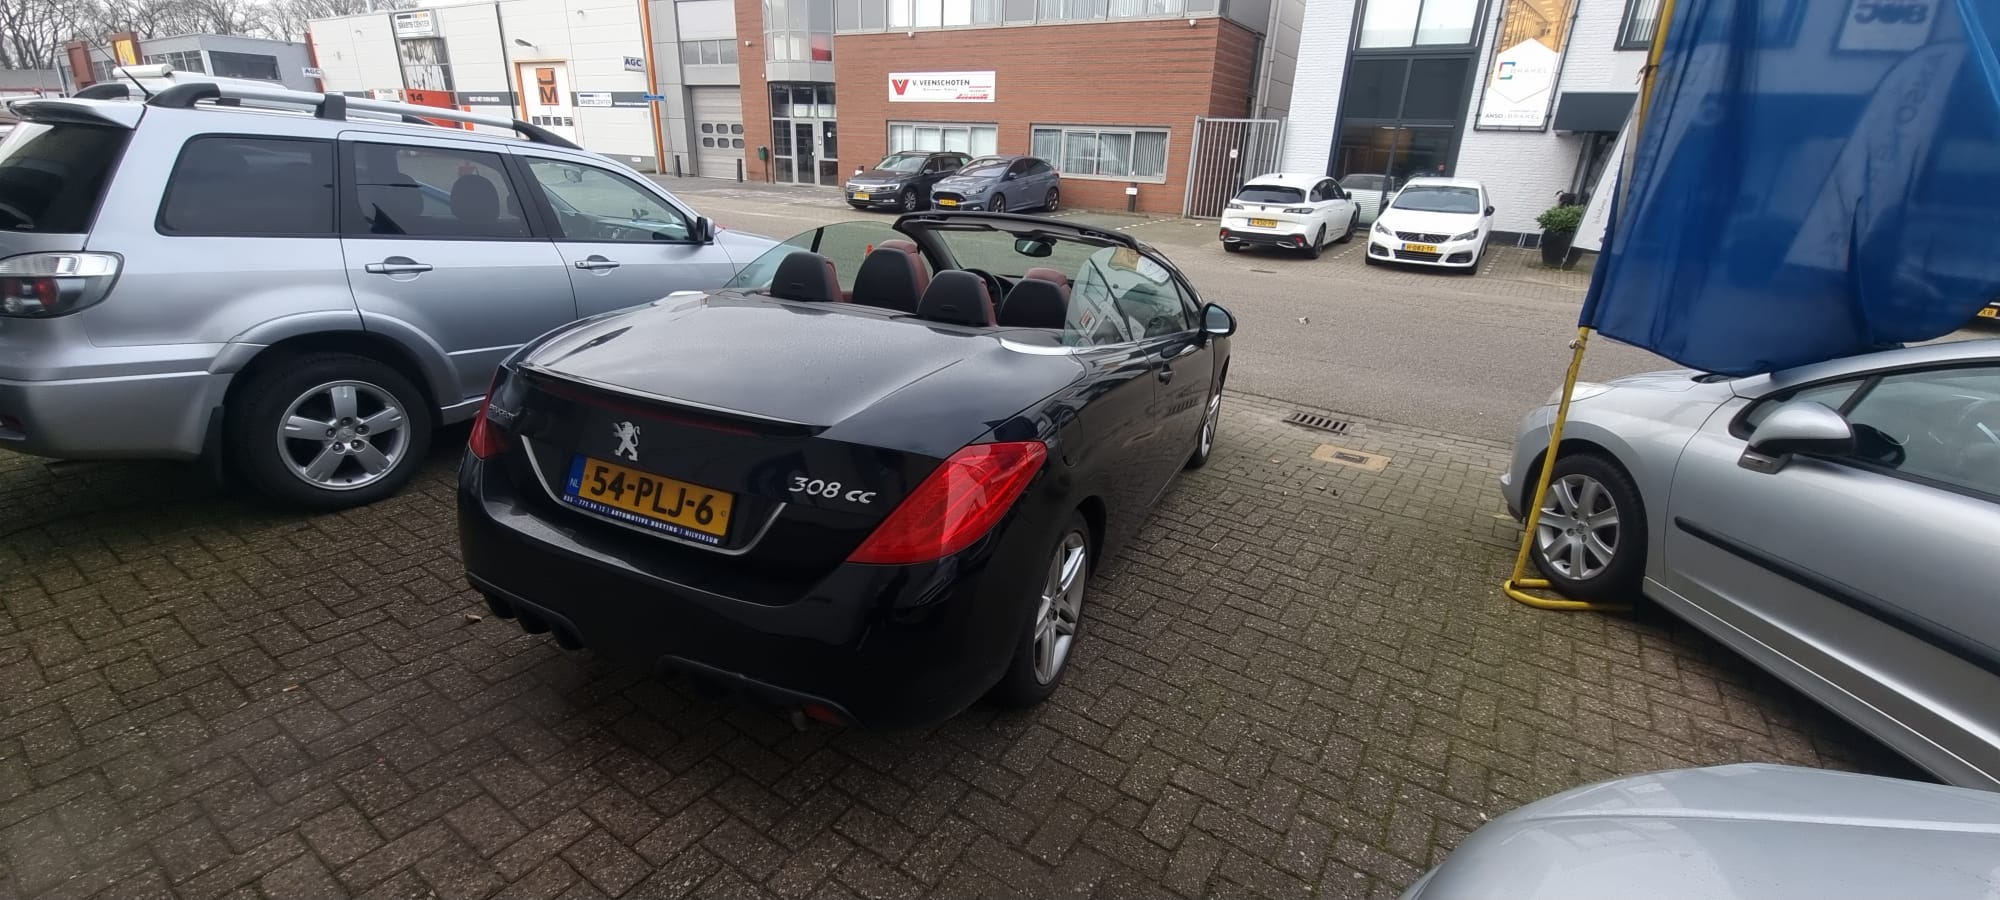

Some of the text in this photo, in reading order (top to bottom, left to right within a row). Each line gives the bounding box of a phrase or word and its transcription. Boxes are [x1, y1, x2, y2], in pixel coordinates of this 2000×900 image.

[625, 58, 641, 67] AGC
[410, 93, 424, 102] 14
[569, 478, 579, 488] NL
[788, 476, 841, 498] 308
[590, 465, 715, 526] 54-PLJ-6
[611, 509, 649, 525] AUTOMOTIVE
[685, 529, 719, 544] HILVERSUM
